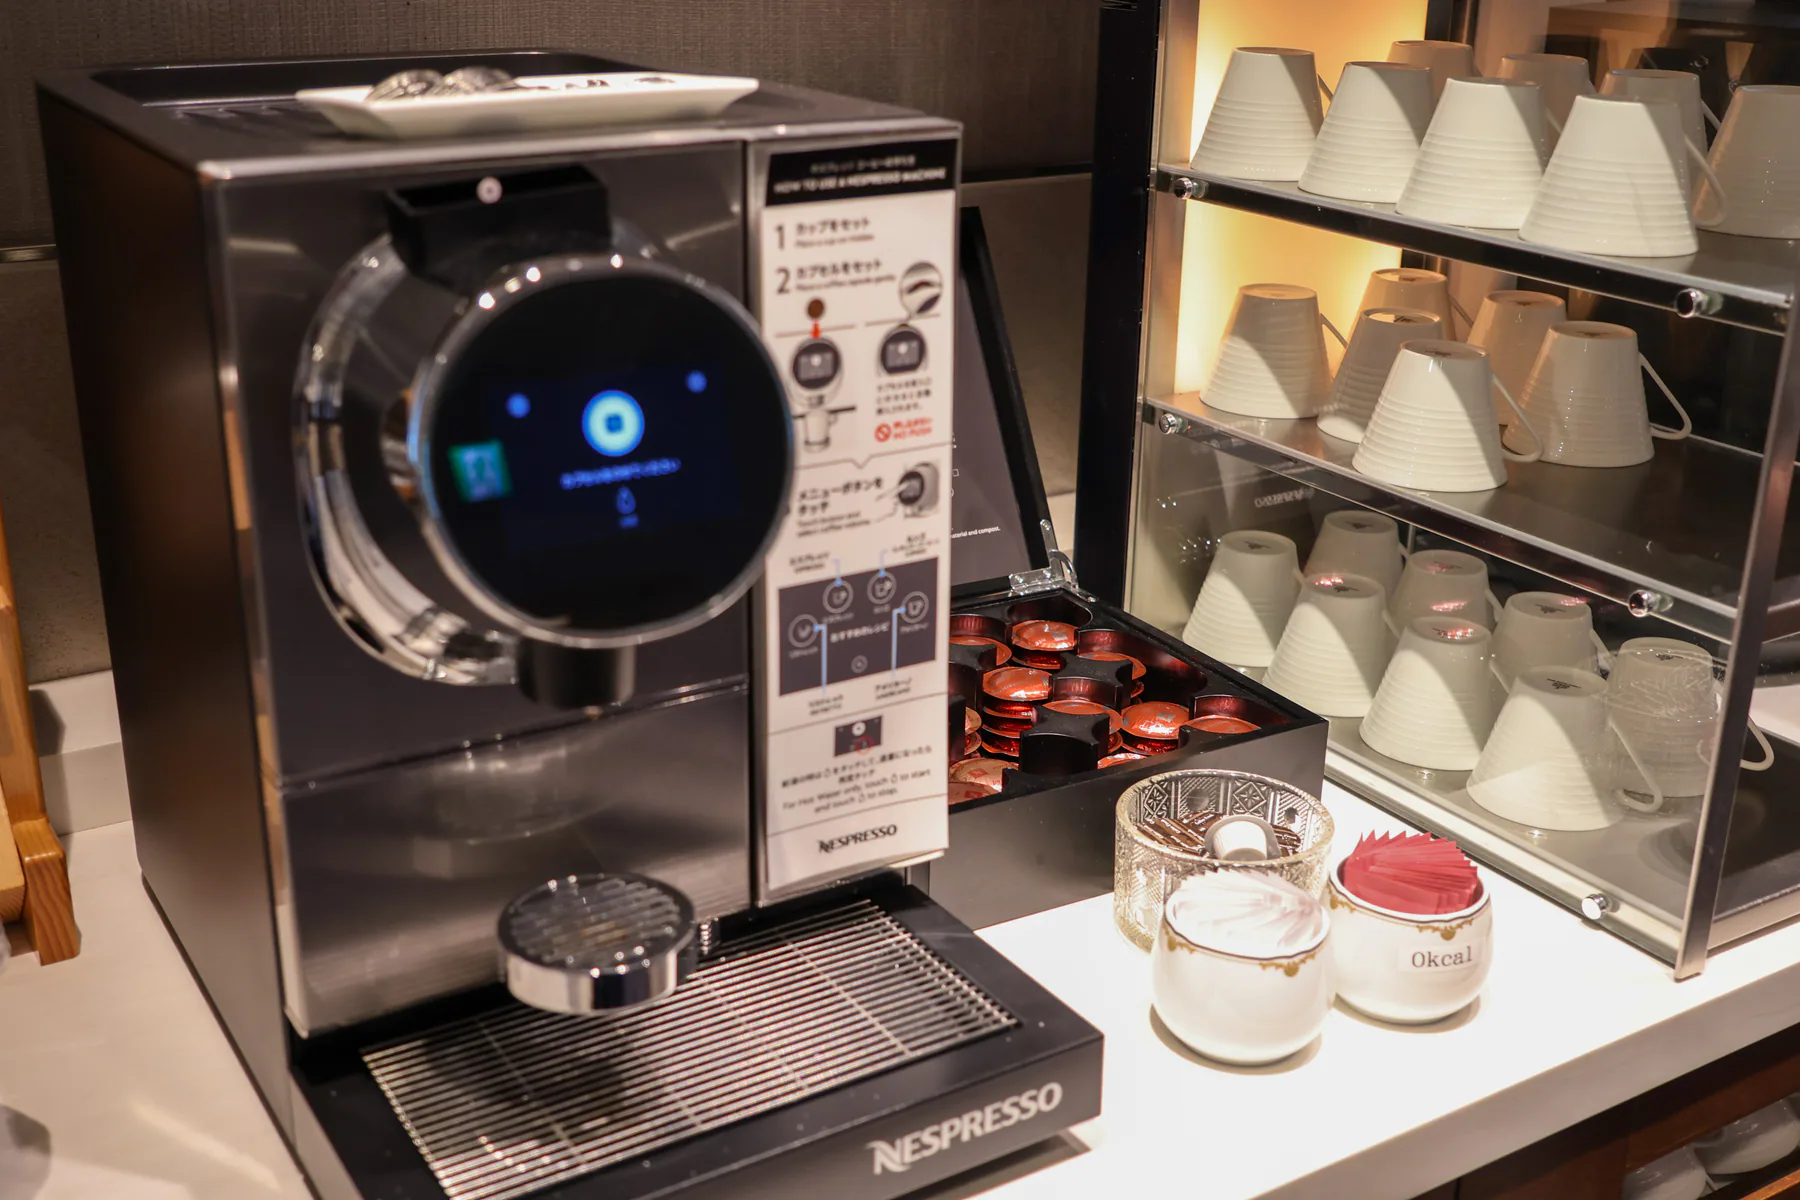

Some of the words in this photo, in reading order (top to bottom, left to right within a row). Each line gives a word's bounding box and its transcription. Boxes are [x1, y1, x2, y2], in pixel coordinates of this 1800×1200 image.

[775, 224, 786, 250] 1
[775, 267, 790, 295] 2
[817, 823, 898, 854] NESPRESSO
[866, 1081, 1063, 1176] NESPRESSO
